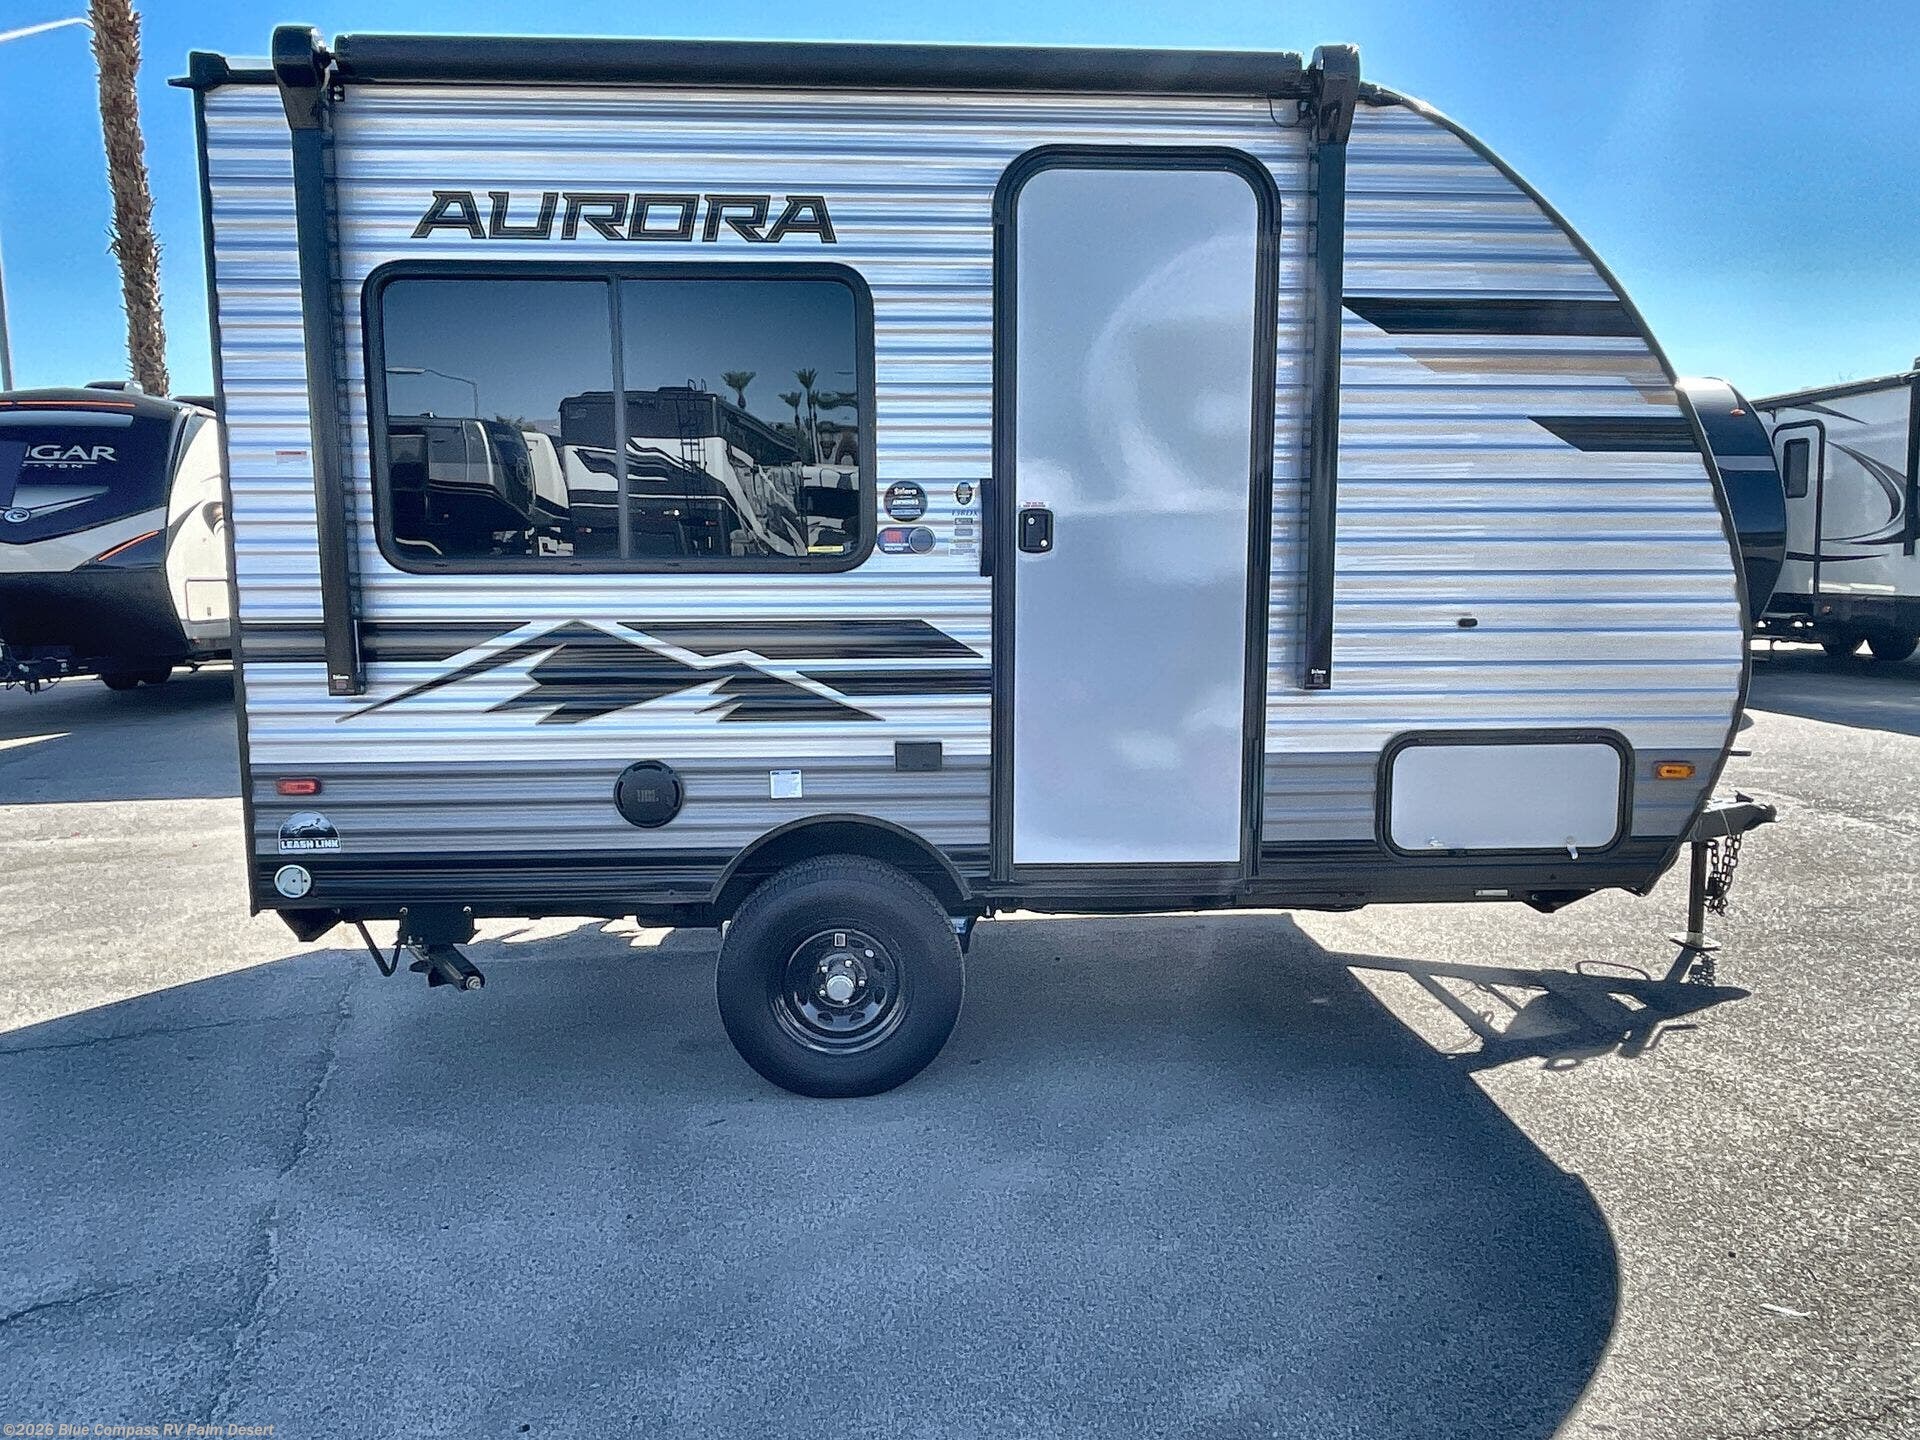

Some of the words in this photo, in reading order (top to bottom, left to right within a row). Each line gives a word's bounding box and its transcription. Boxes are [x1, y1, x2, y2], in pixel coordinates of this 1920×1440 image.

[410, 190, 838, 244] AURORA
[281, 840, 314, 849] LEASH
[315, 839, 339, 848] LINK
